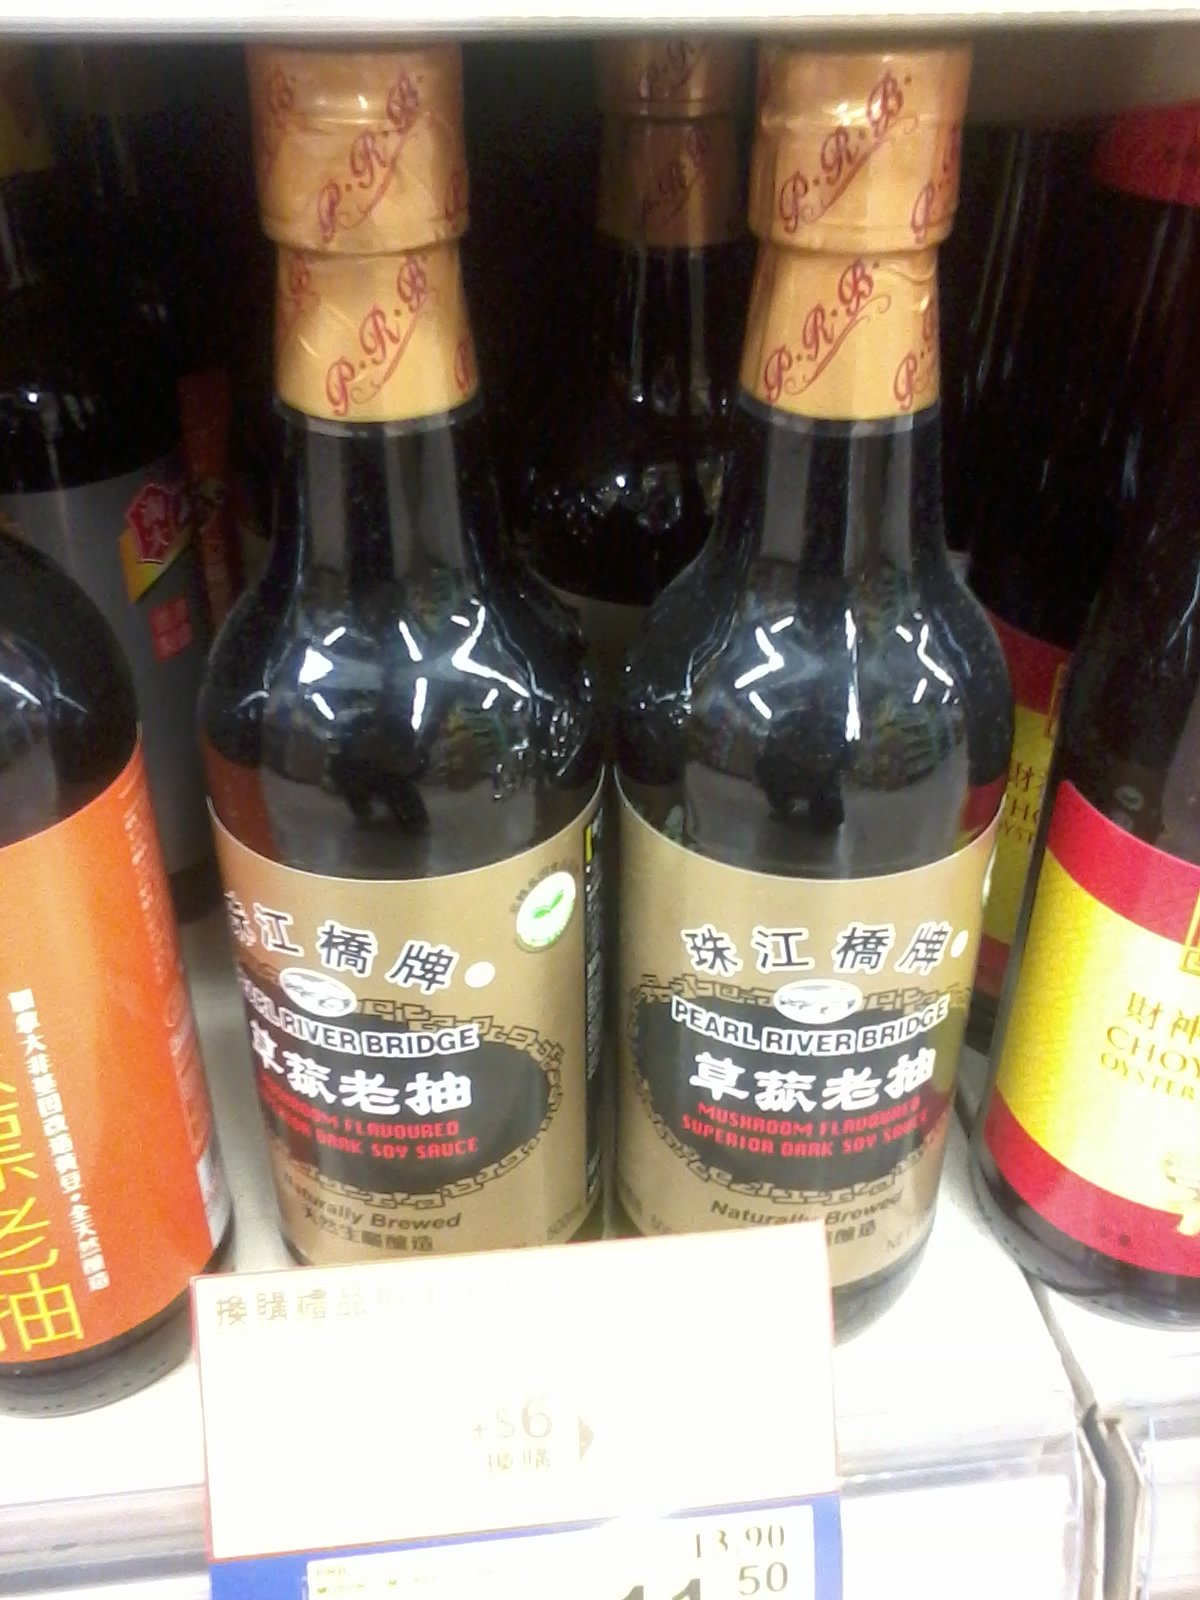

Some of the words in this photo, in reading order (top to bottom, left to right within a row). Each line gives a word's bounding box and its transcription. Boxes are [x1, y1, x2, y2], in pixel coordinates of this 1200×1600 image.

[681, 920, 952, 976] 珠江橋牌
[279, 1006, 362, 1059] RIVER
[362, 1023, 481, 1058] BRIDGE
[671, 994, 760, 1050] PEARL
[762, 1026, 854, 1056] RIVER
[855, 992, 951, 1051] BRIDGE
[682, 1114, 775, 1155] SUPERIOR
[780, 1139, 834, 1158] DARK
[842, 1133, 879, 1155] SOY
[697, 1101, 814, 1138] MUSHROOM
[371, 1142, 408, 1160] SOY
[416, 1136, 479, 1160] SAUCE
[370, 1211, 463, 1232] Brewed
